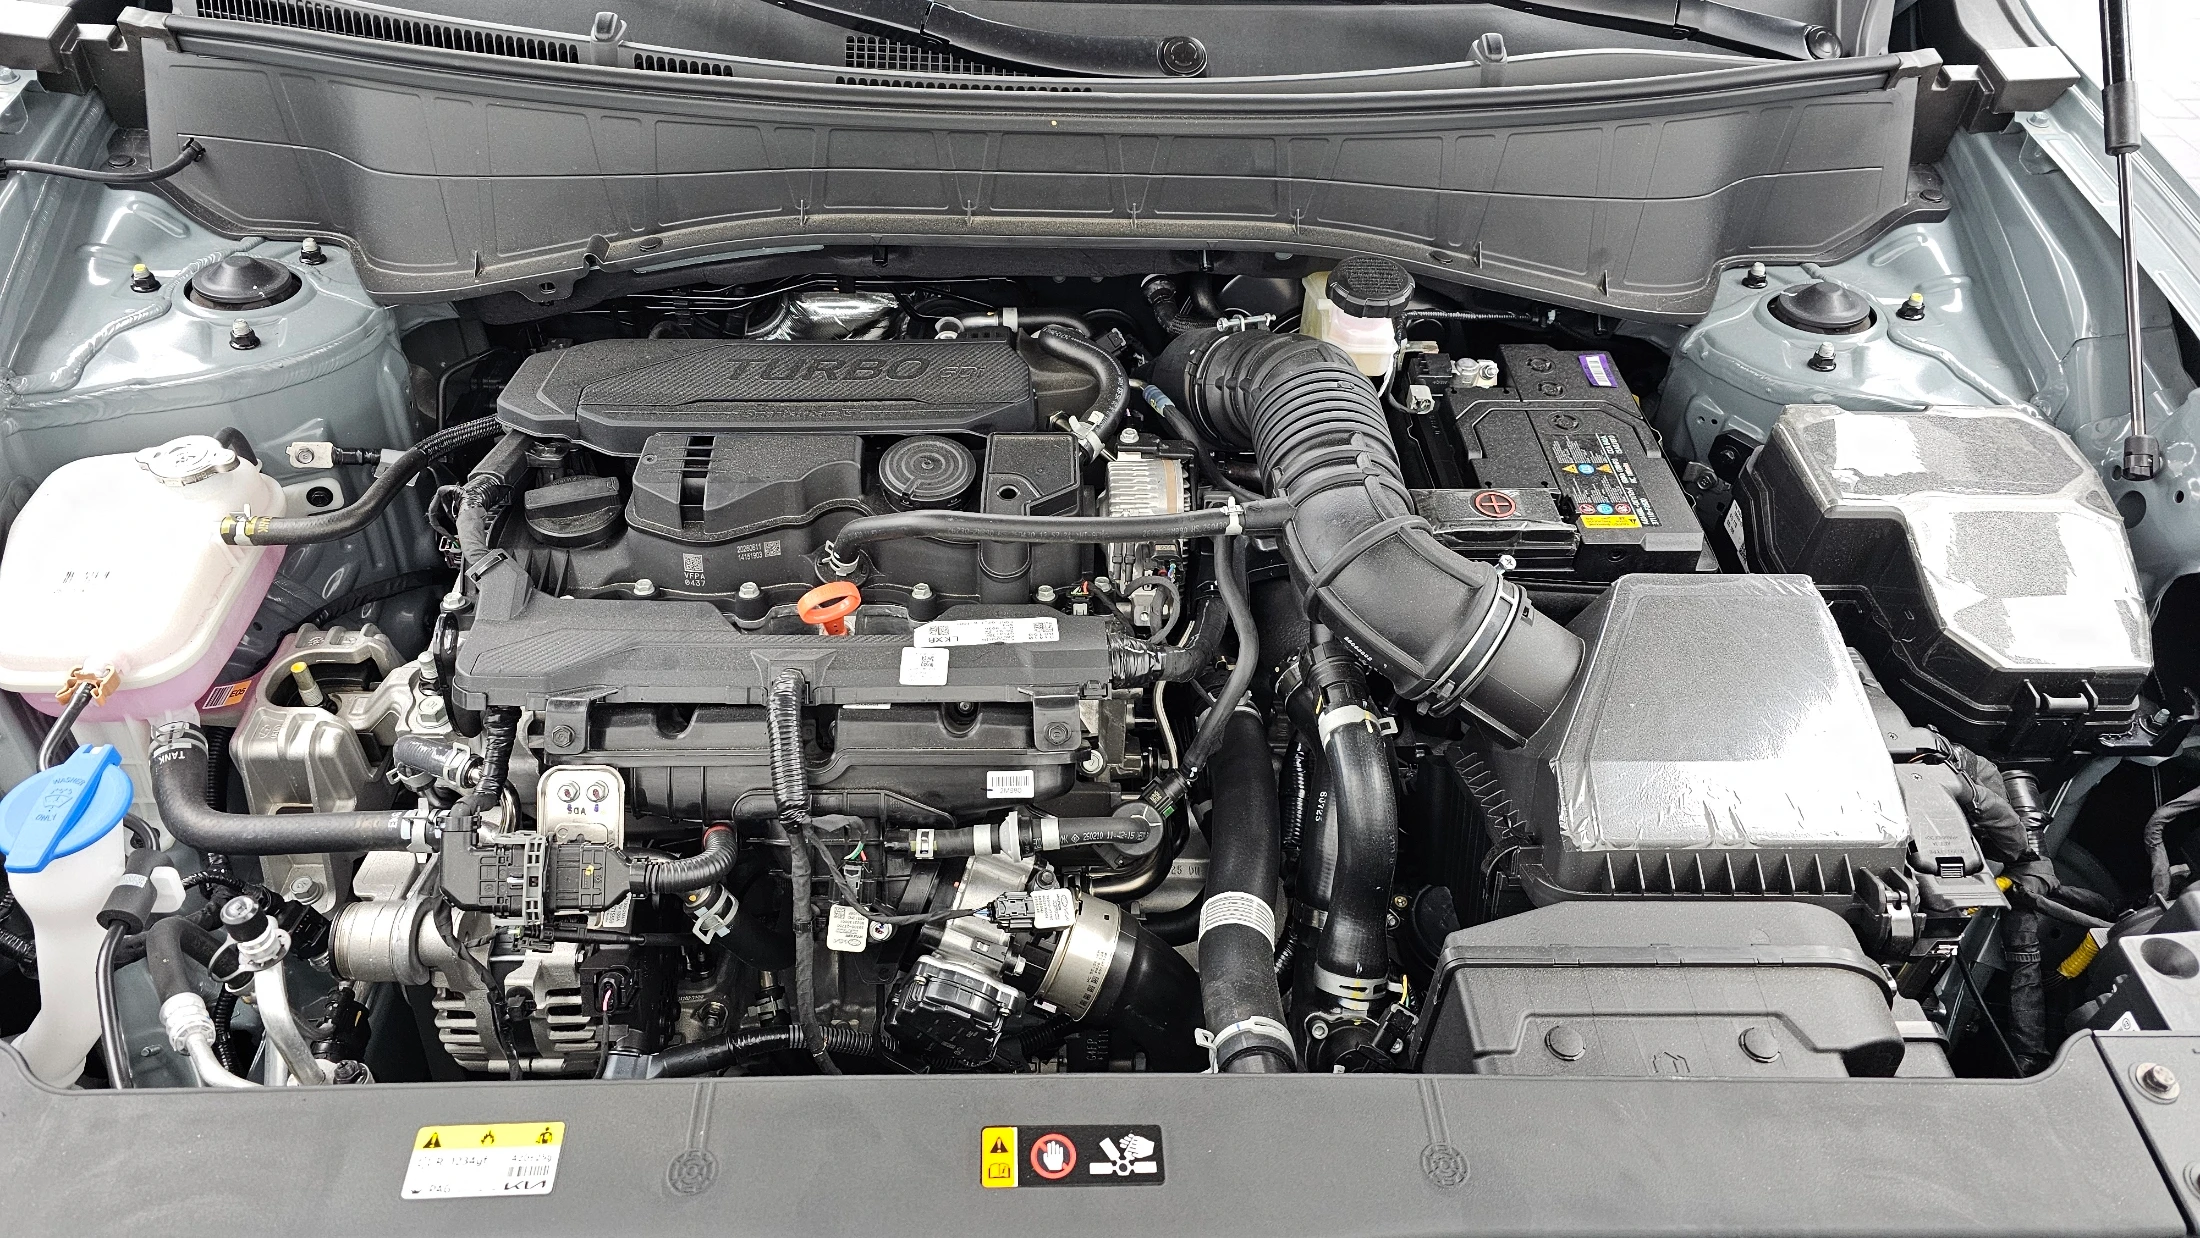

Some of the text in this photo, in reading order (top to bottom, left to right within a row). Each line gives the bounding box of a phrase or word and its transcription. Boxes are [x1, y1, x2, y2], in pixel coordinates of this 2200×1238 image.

[727, 358, 931, 382] TURBO
[158, 750, 186, 765] TANK
[53, 776, 86, 787] WASHER
[35, 813, 57, 822] ONLY
[504, 1180, 547, 1191] KIA
